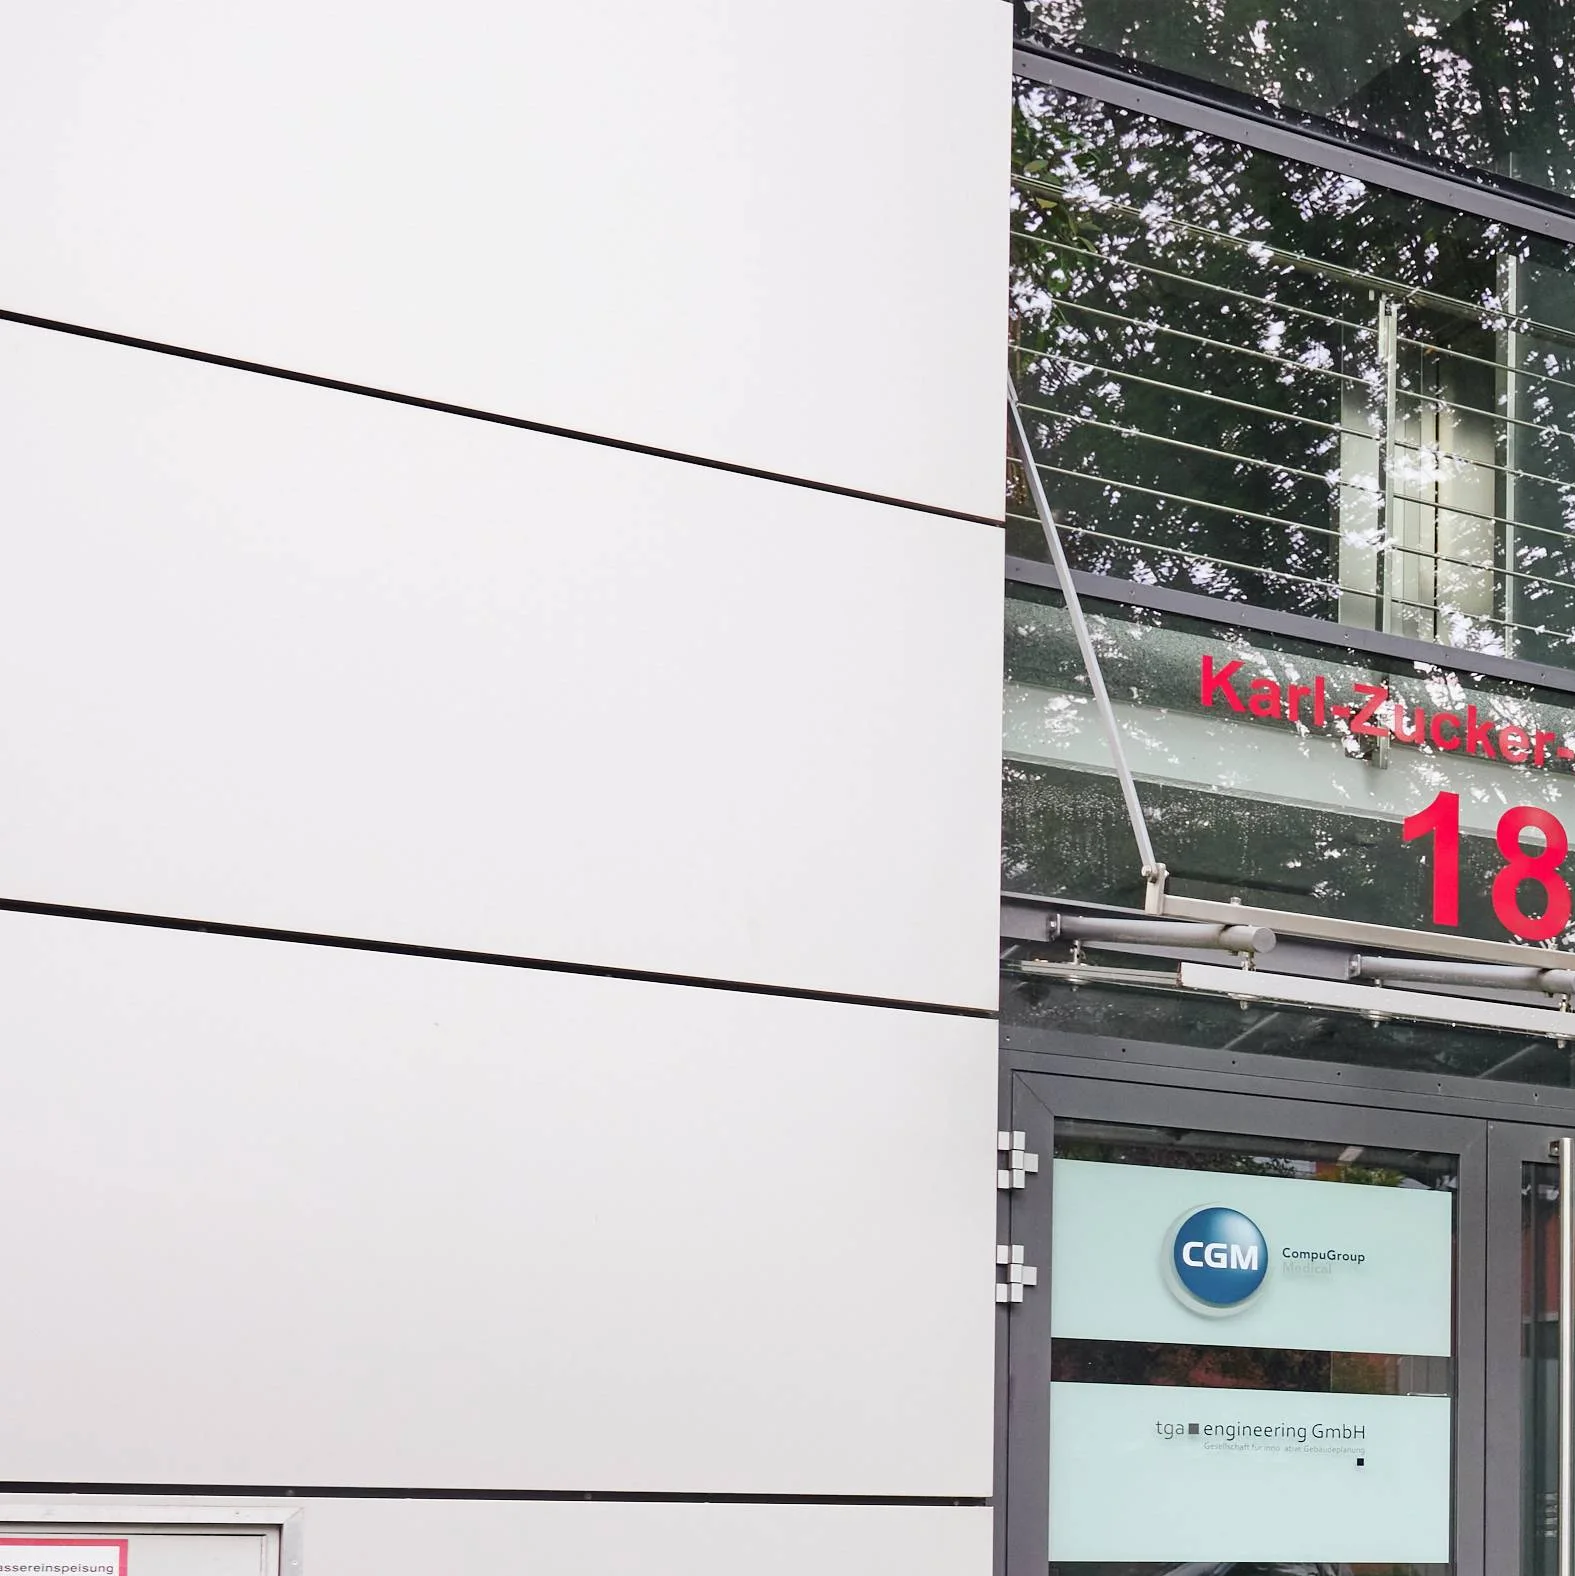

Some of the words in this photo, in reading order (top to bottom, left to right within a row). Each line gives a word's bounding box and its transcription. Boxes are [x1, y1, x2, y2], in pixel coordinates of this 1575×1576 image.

[1404, 791, 1572, 941] 18
[1182, 1241, 1258, 1271] CGM
[1282, 1247, 1366, 1265] CompuGroup
[1155, 1420, 1185, 1440] tga
[1204, 1420, 1307, 1443] engineering
[1312, 1423, 1365, 1440] GmbH
